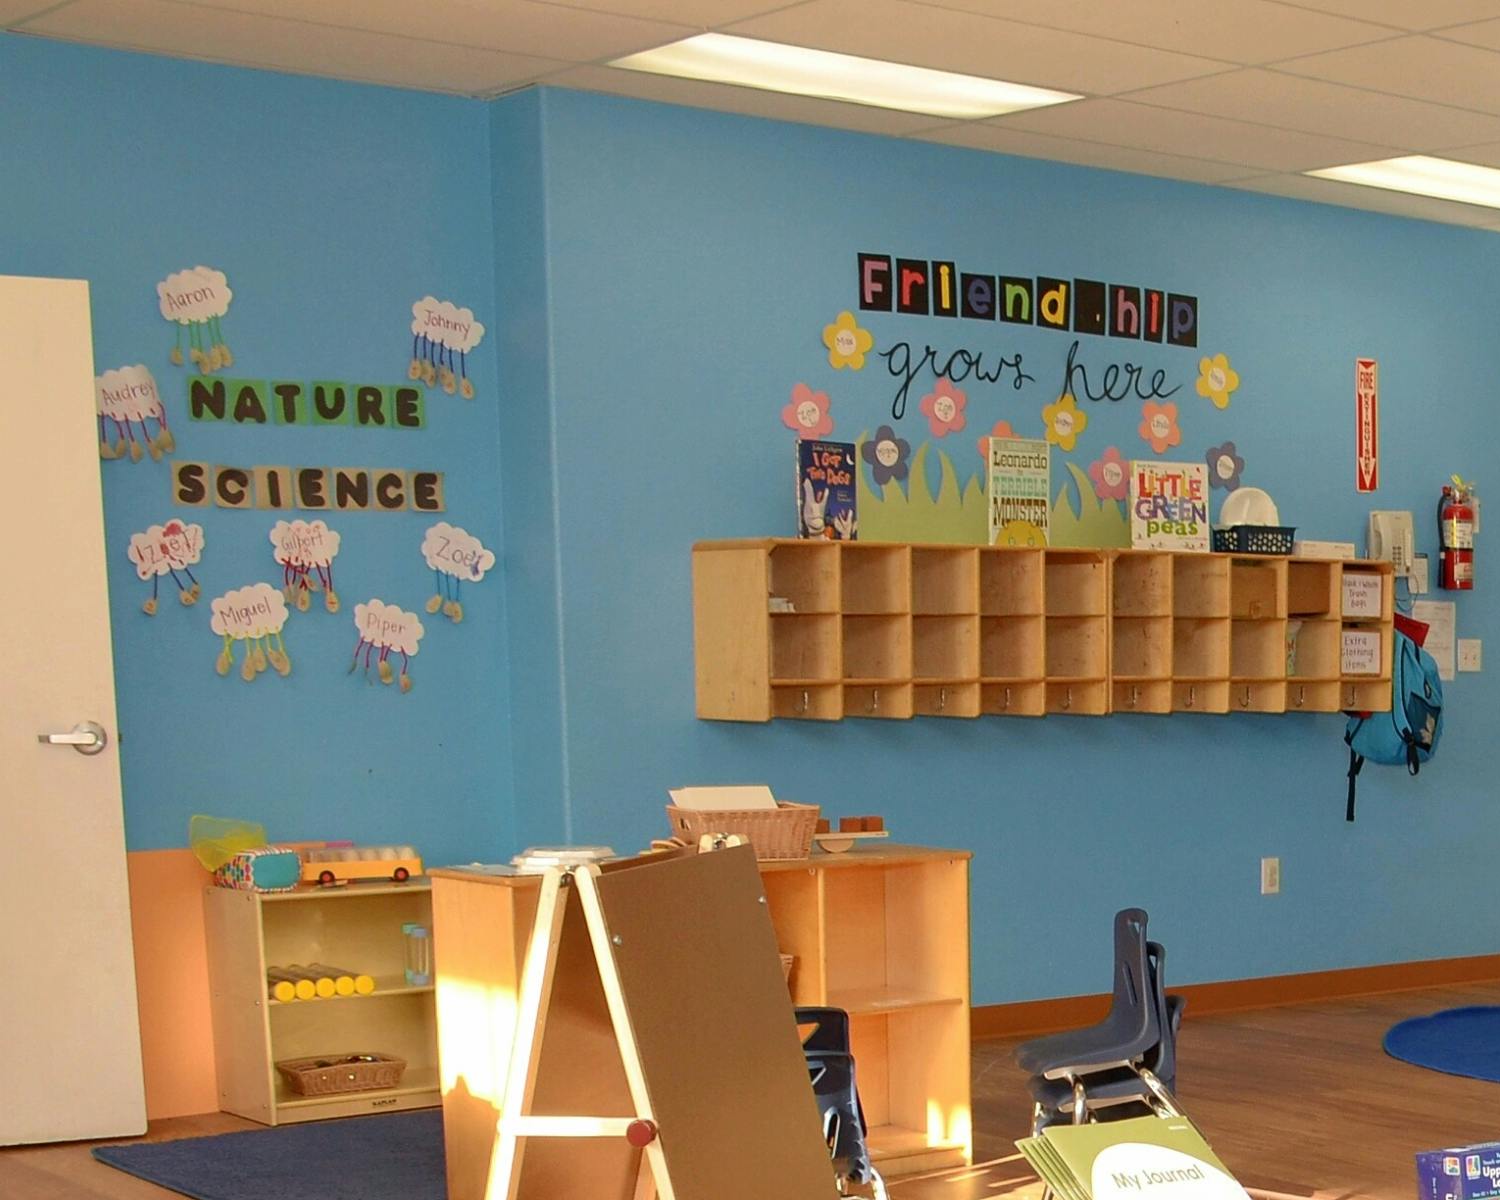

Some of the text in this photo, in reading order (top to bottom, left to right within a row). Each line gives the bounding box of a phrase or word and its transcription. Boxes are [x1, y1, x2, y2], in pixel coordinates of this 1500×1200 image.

[165, 286, 216, 312] Aaron
[424, 309, 471, 341] Johnny
[878, 340, 1184, 420] grows here
[1360, 371, 1373, 390] FIRE
[189, 379, 421, 428] NATURE
[993, 451, 1048, 469] Leonardo
[177, 463, 440, 510] SCIENCE
[1138, 473, 1202, 500] LITTLE
[993, 497, 1048, 528] MONSTER
[1135, 495, 1206, 524] GREEN
[1147, 521, 1198, 537] peas
[219, 597, 272, 626] Miguel
[367, 612, 406, 639] Piper
[1344, 636, 1367, 646] Extra
[1111, 1164, 1205, 1190] My Journal
